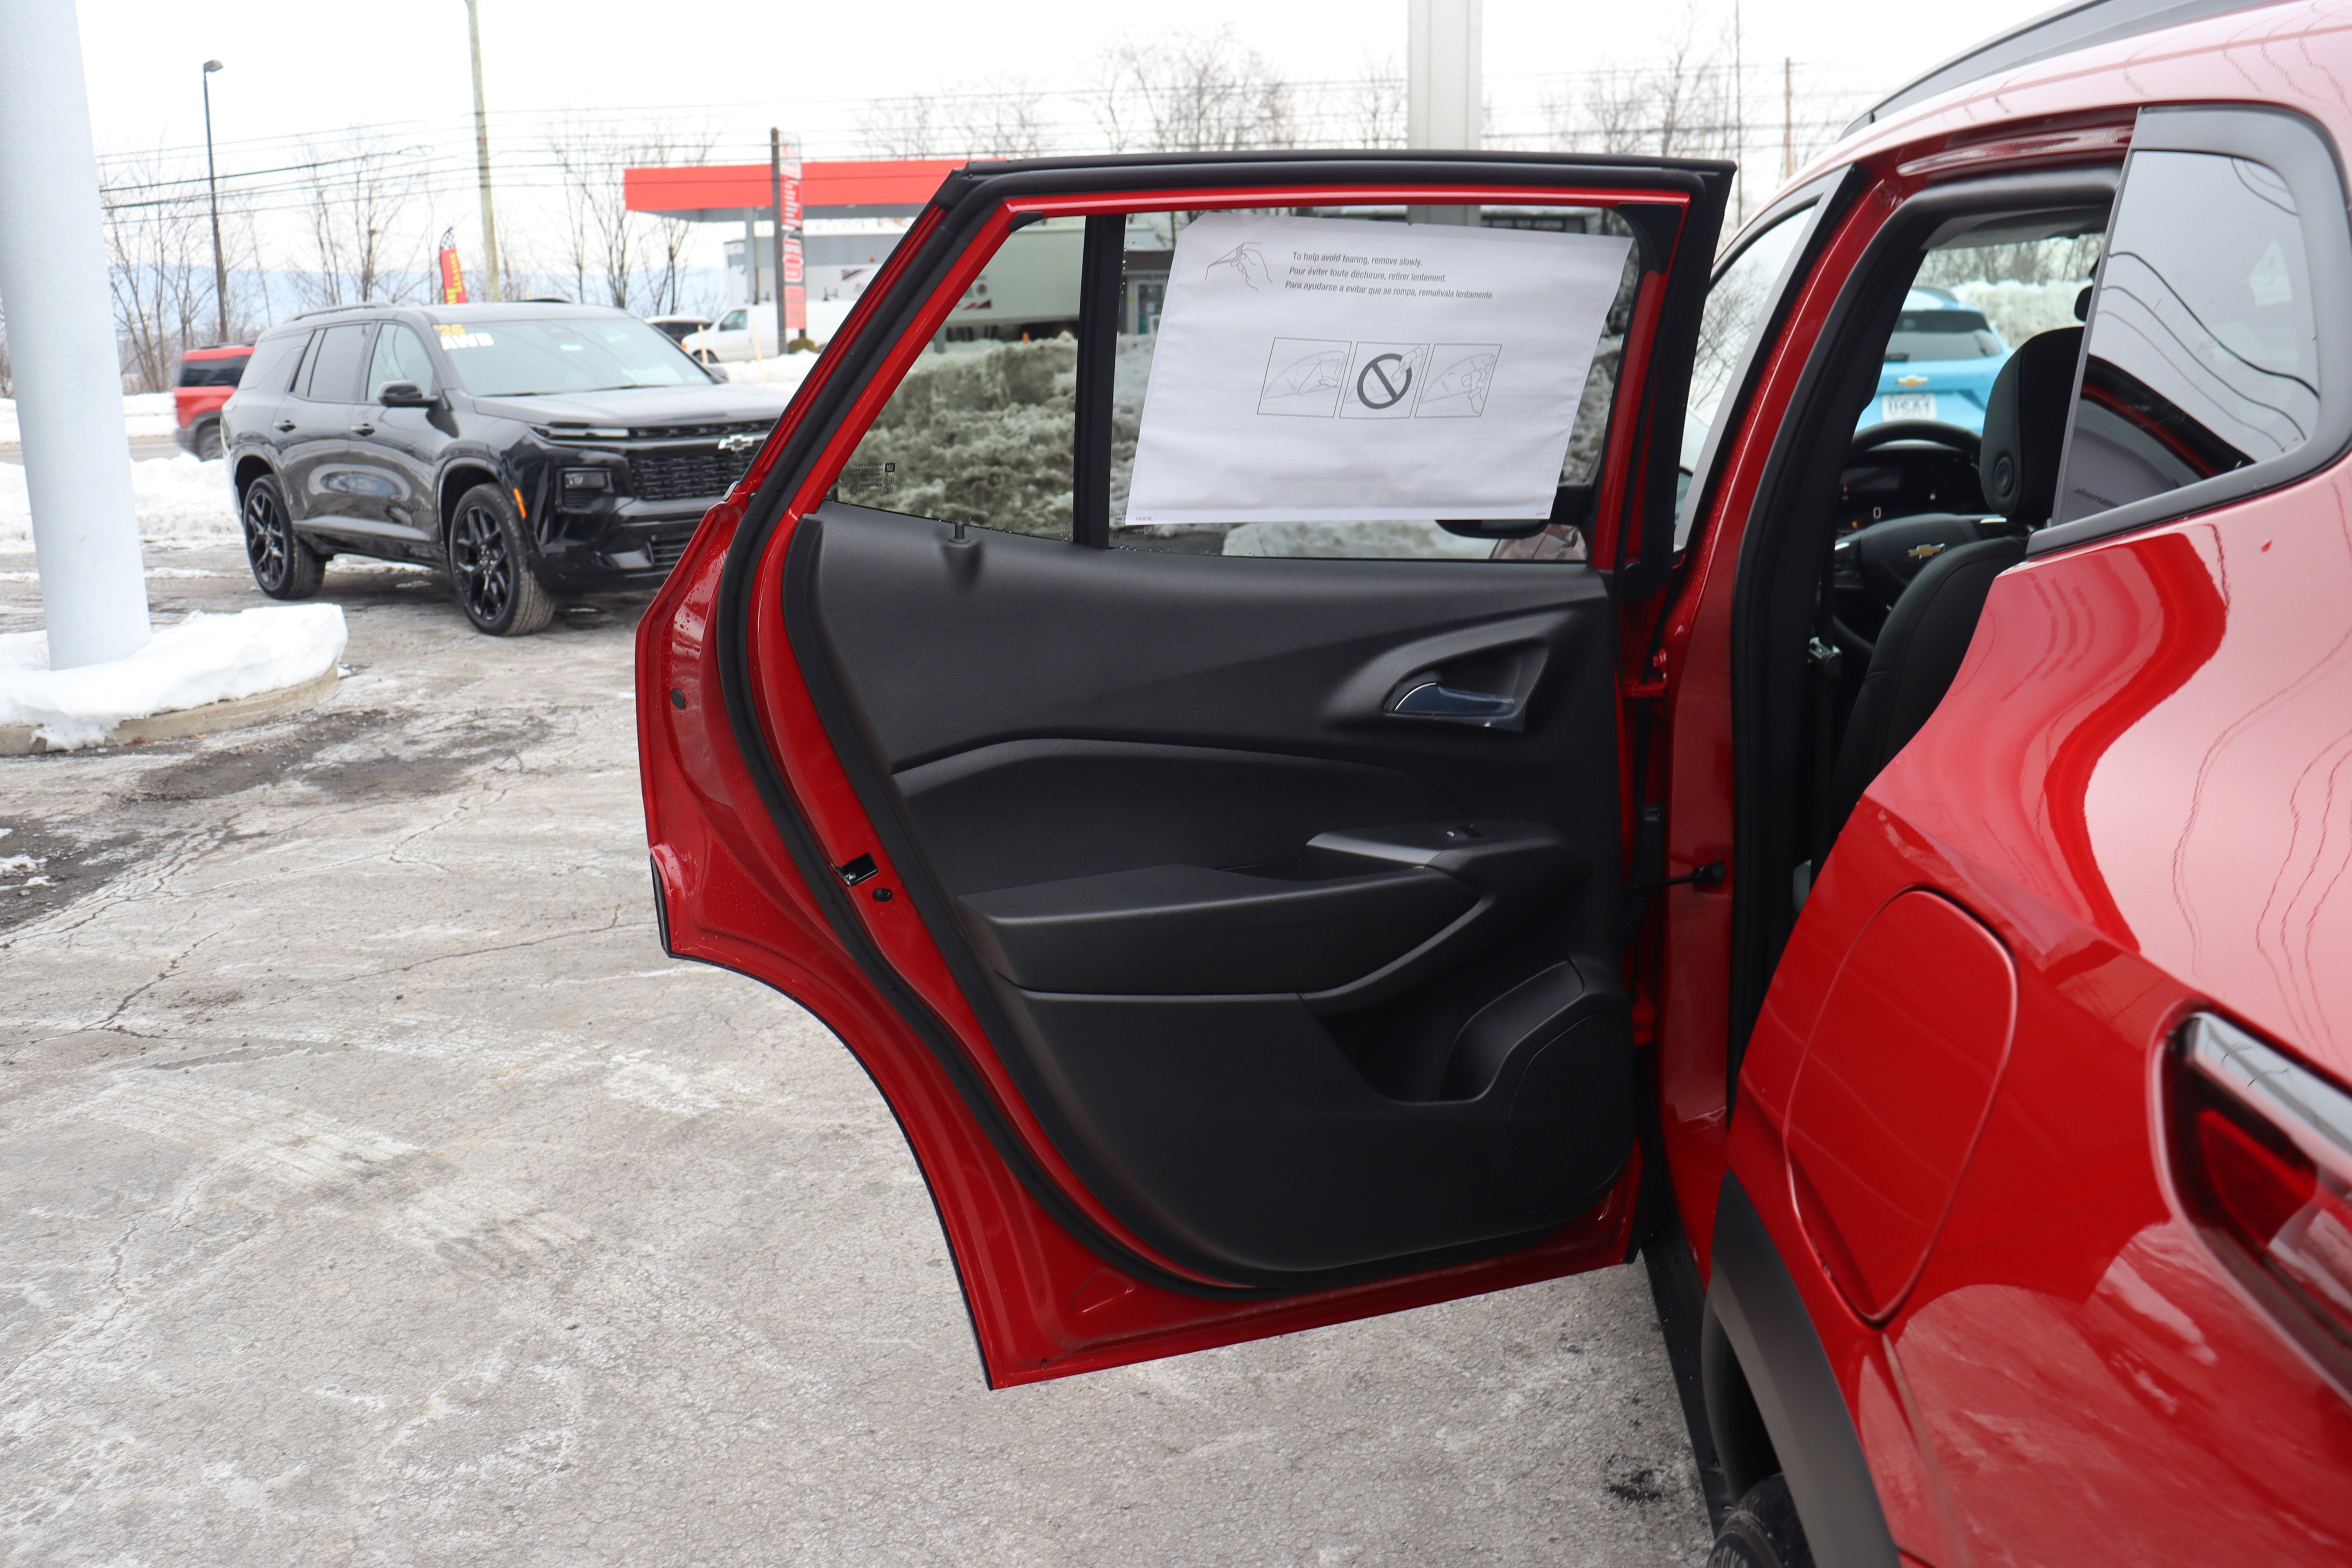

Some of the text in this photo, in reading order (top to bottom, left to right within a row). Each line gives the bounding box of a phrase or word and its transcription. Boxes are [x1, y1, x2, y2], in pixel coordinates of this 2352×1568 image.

[1293, 251, 1422, 268] To help avoid tearing, remove slowly.
[1289, 267, 1446, 283] Pour éviter toute déchirure, retirer lentement.
[1285, 280, 1302, 289] Para
[1304, 282, 1337, 291] ayudarse
[1346, 285, 1367, 294] evitar
[1368, 287, 1381, 296] que
[1393, 288, 1417, 297] rompa,
[1419, 288, 1454, 298] remuévala
[1456, 290, 1493, 299] lentamente.
[440, 332, 494, 350] AWD
[1873, 506, 1881, 519] 0
